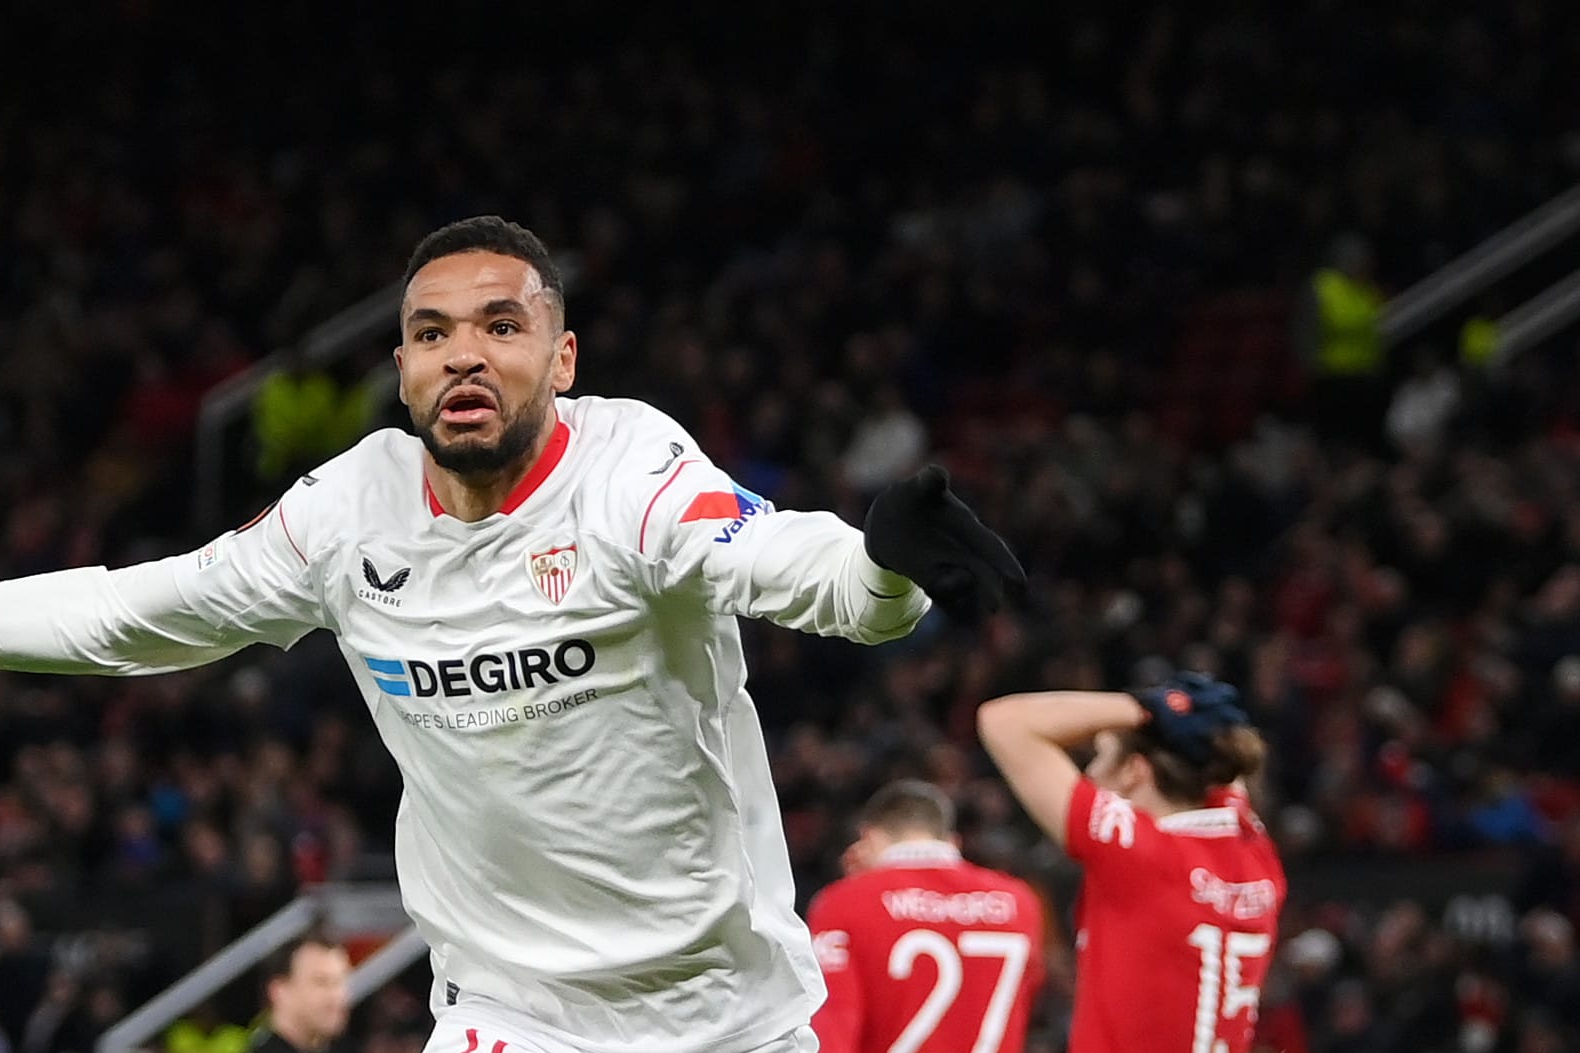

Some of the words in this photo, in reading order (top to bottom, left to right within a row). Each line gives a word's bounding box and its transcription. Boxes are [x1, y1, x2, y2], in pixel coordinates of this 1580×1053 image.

[358, 589, 403, 608] CASTORE
[407, 638, 596, 698] DEGIRO
[446, 707, 519, 729] LEADING
[523, 688, 598, 720] BROKER
